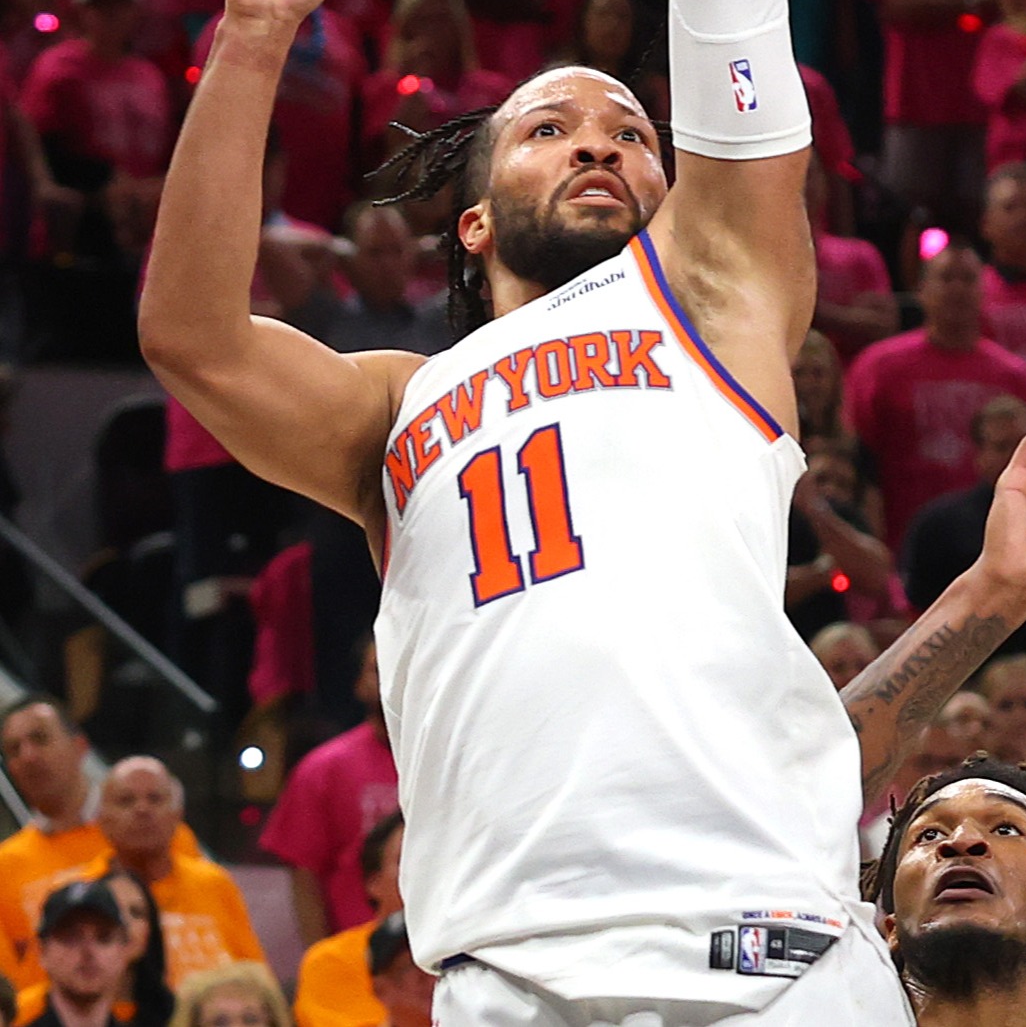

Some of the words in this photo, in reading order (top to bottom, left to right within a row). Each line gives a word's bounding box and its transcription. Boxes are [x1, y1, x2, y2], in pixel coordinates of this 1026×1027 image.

[383, 365, 488, 522] NEW
[494, 329, 674, 416] YORK
[458, 421, 585, 608] 11
